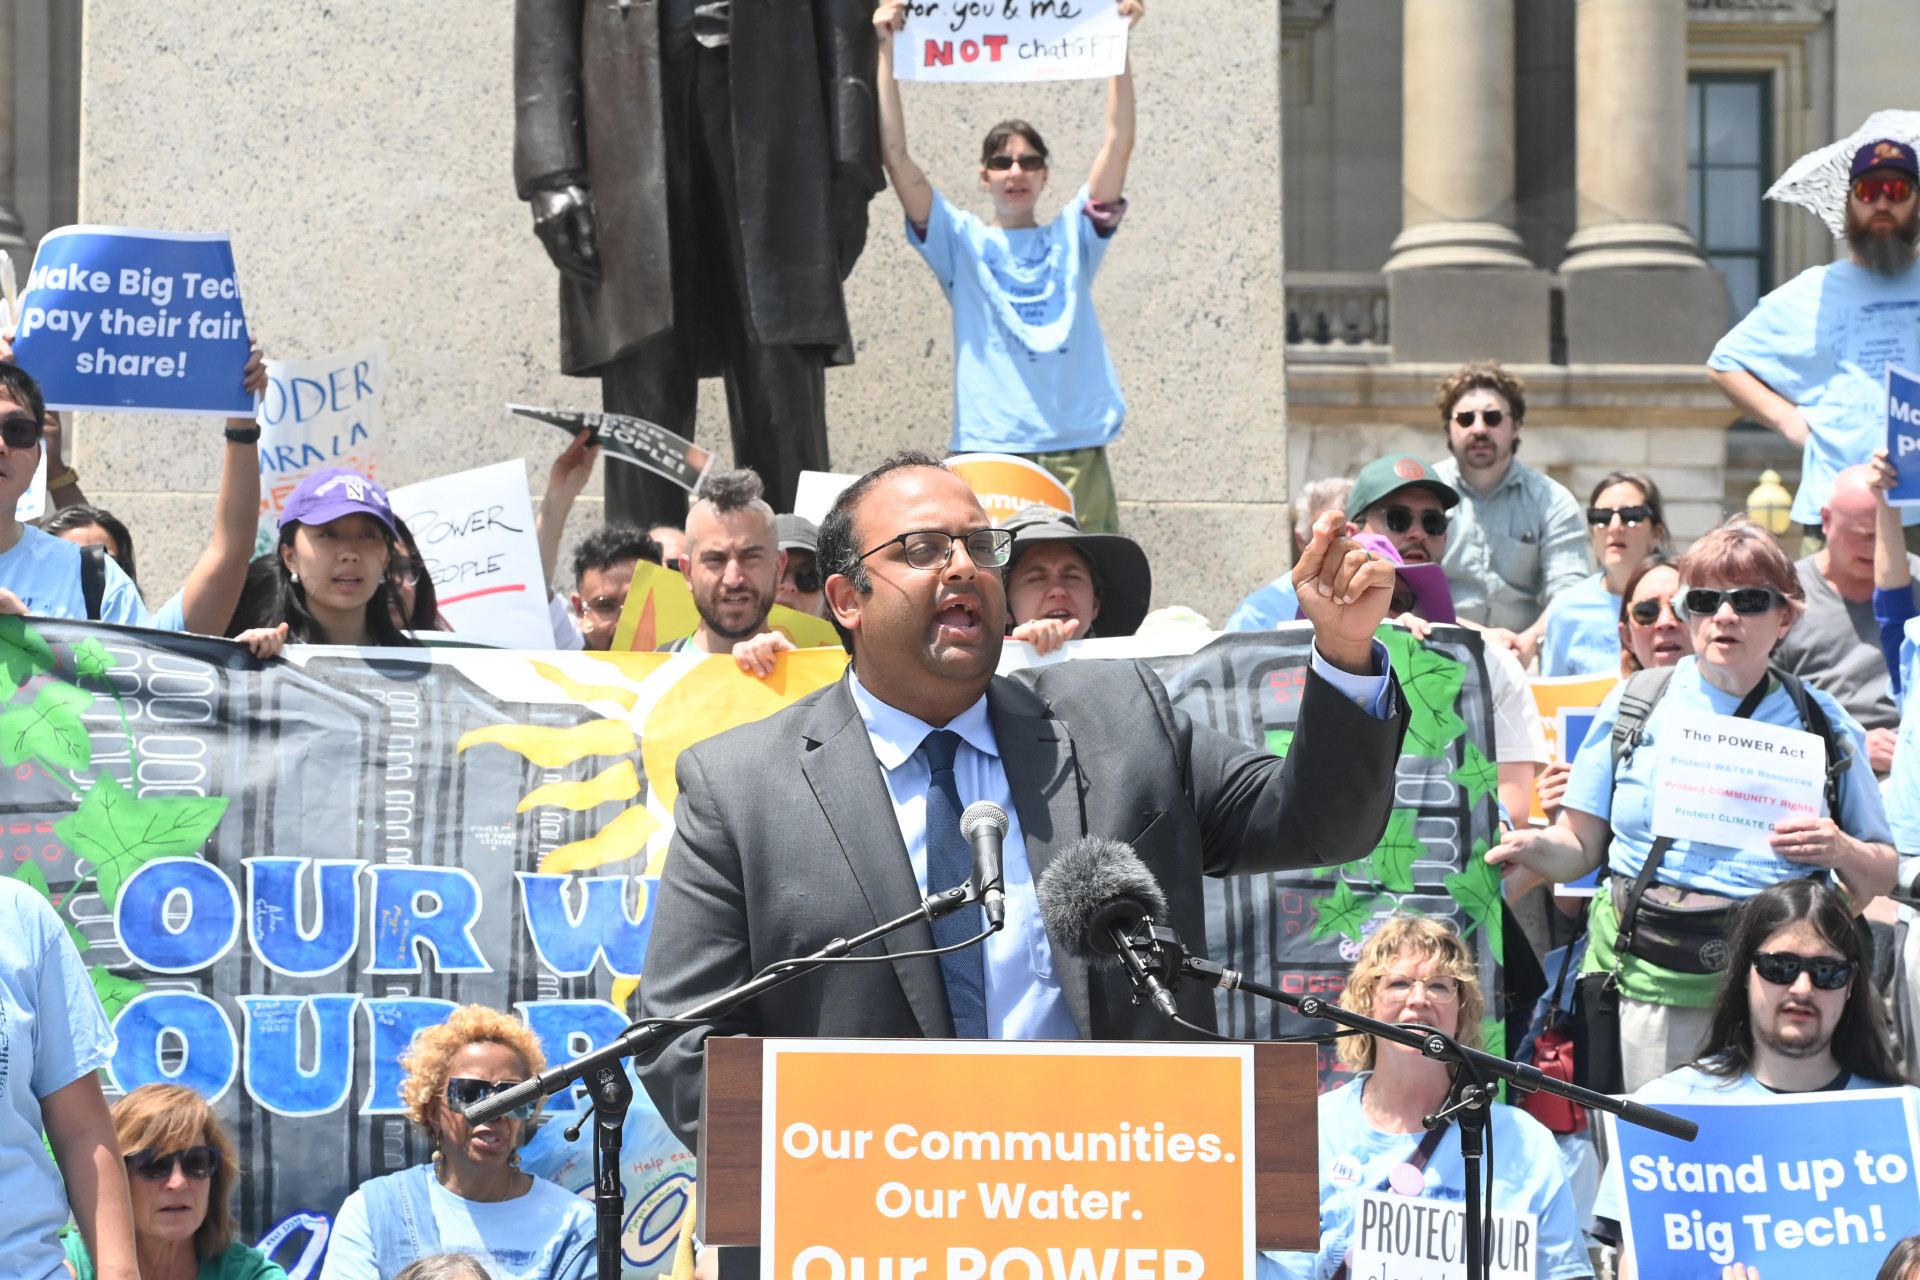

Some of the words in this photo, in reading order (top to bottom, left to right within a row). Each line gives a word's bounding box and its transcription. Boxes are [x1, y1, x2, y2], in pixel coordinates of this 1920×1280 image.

[949, 0, 994, 32] you
[1031, 0, 1083, 19] me
[924, 35, 1008, 67] NOT
[119, 268, 174, 306] Big
[22, 307, 93, 341] pay
[100, 308, 182, 338] their
[189, 311, 242, 340] fair
[75, 347, 188, 378] share!
[405, 505, 523, 544] POWER
[1683, 728, 1712, 743] The
[1718, 734, 1774, 753] POWER
[1780, 746, 1805, 759] Act
[1671, 756, 1712, 770] Protect
[1715, 762, 1754, 776] WATER
[1758, 770, 1813, 787] Resources
[1665, 780, 1705, 794] Protect
[1708, 786, 1777, 806] COMMUNITY
[1780, 799, 1814, 814] Rights
[1675, 807, 1716, 821] Protect
[1718, 814, 1765, 830] CLIMATE
[117, 858, 493, 975] OUR
[782, 1122, 872, 1159] Our
[884, 1121, 1235, 1163] Communities.
[633, 1156, 664, 1174] Help
[1629, 1154, 1767, 1193] Stand
[1778, 1158, 1845, 1201] up
[1854, 1150, 1907, 1184] to
[876, 1181, 966, 1218] Our
[977, 1183, 1143, 1220] Water.
[1361, 1198, 1467, 1264] PROTECT
[1664, 1209, 1735, 1265] Big
[1742, 1204, 1886, 1250] Tech!
[792, 1245, 927, 1280] Our
